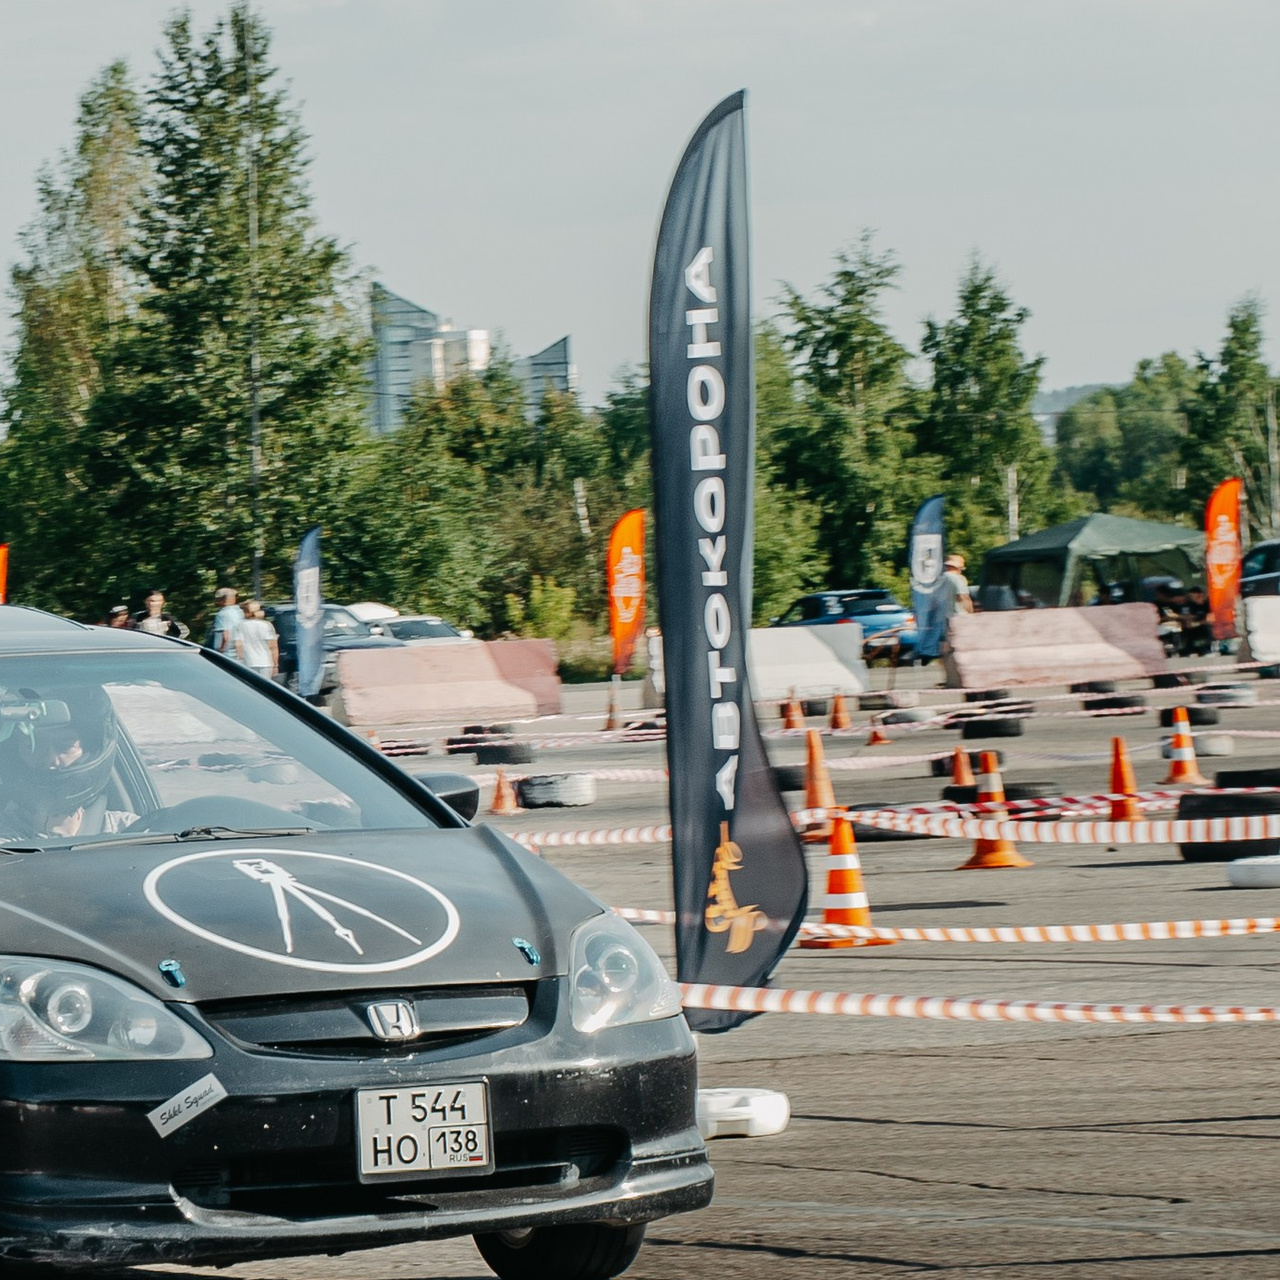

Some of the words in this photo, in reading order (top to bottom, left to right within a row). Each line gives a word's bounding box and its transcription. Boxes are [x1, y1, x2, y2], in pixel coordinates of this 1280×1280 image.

[684, 246, 741, 811] АВТОКОРОНА
[184, 1083, 215, 1108] Squad
[411, 1091, 466, 1122] 544
[436, 1130, 478, 1154] 138
[449, 1154, 469, 1162] RUS
